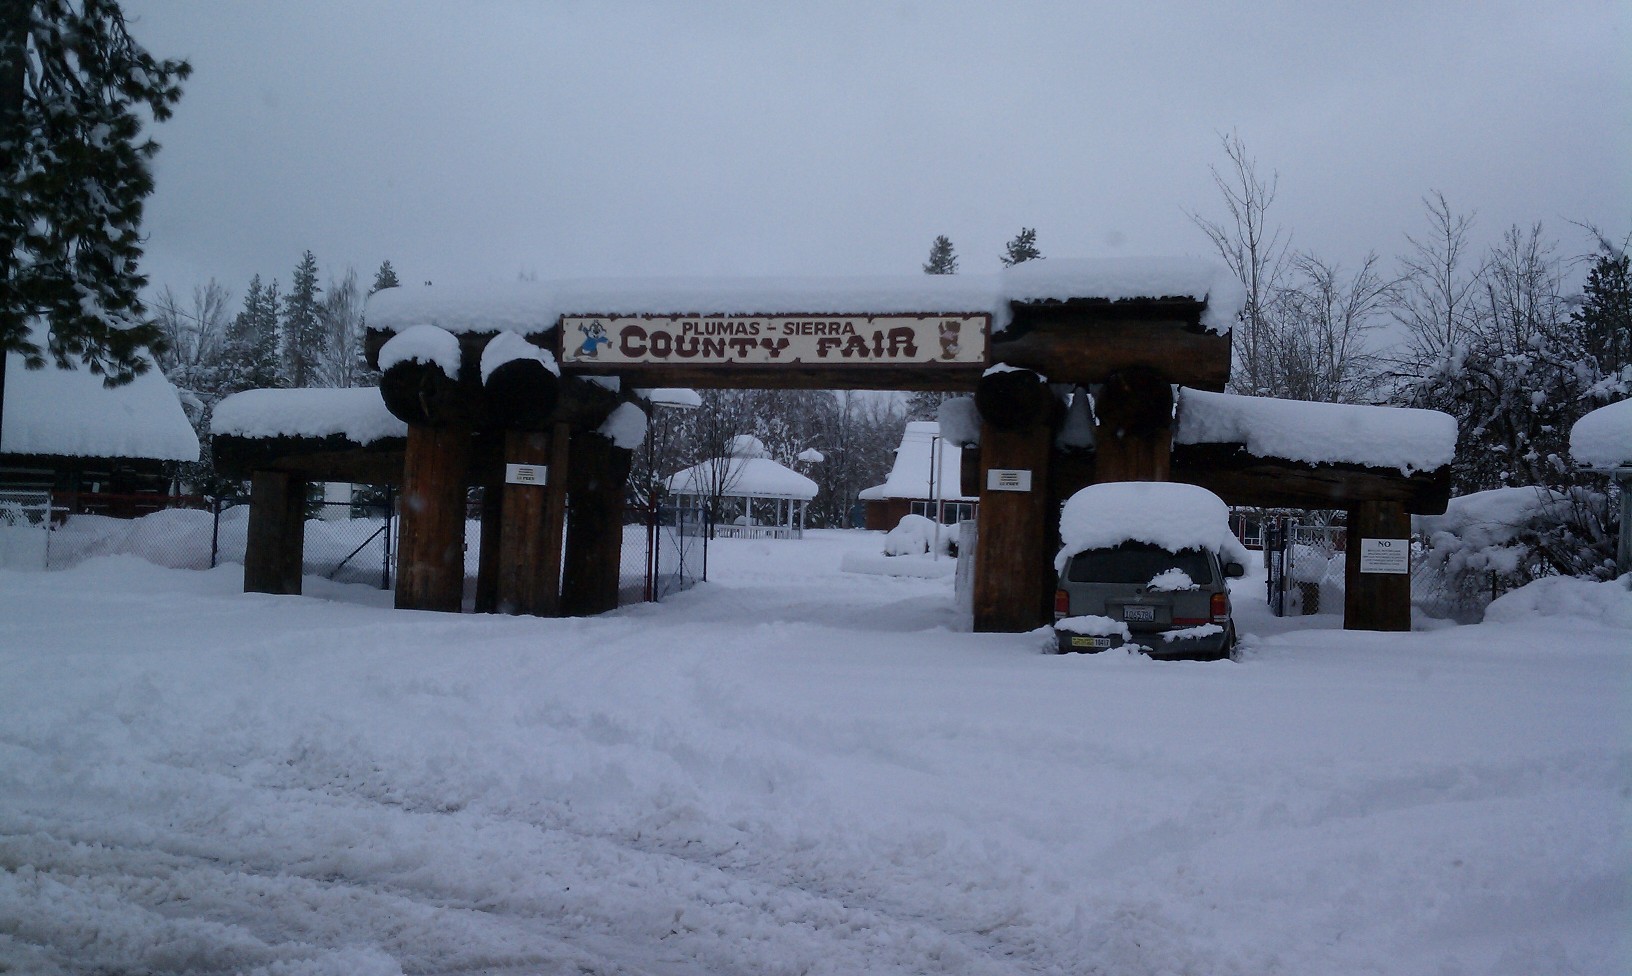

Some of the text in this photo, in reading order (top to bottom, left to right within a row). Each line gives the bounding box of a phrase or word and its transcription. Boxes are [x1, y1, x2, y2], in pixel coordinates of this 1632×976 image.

[682, 321, 761, 336] PLUMAS
[782, 321, 856, 336] SIERRA
[619, 324, 919, 358] COUNTY FAIR
[1377, 540, 1392, 548] NO
